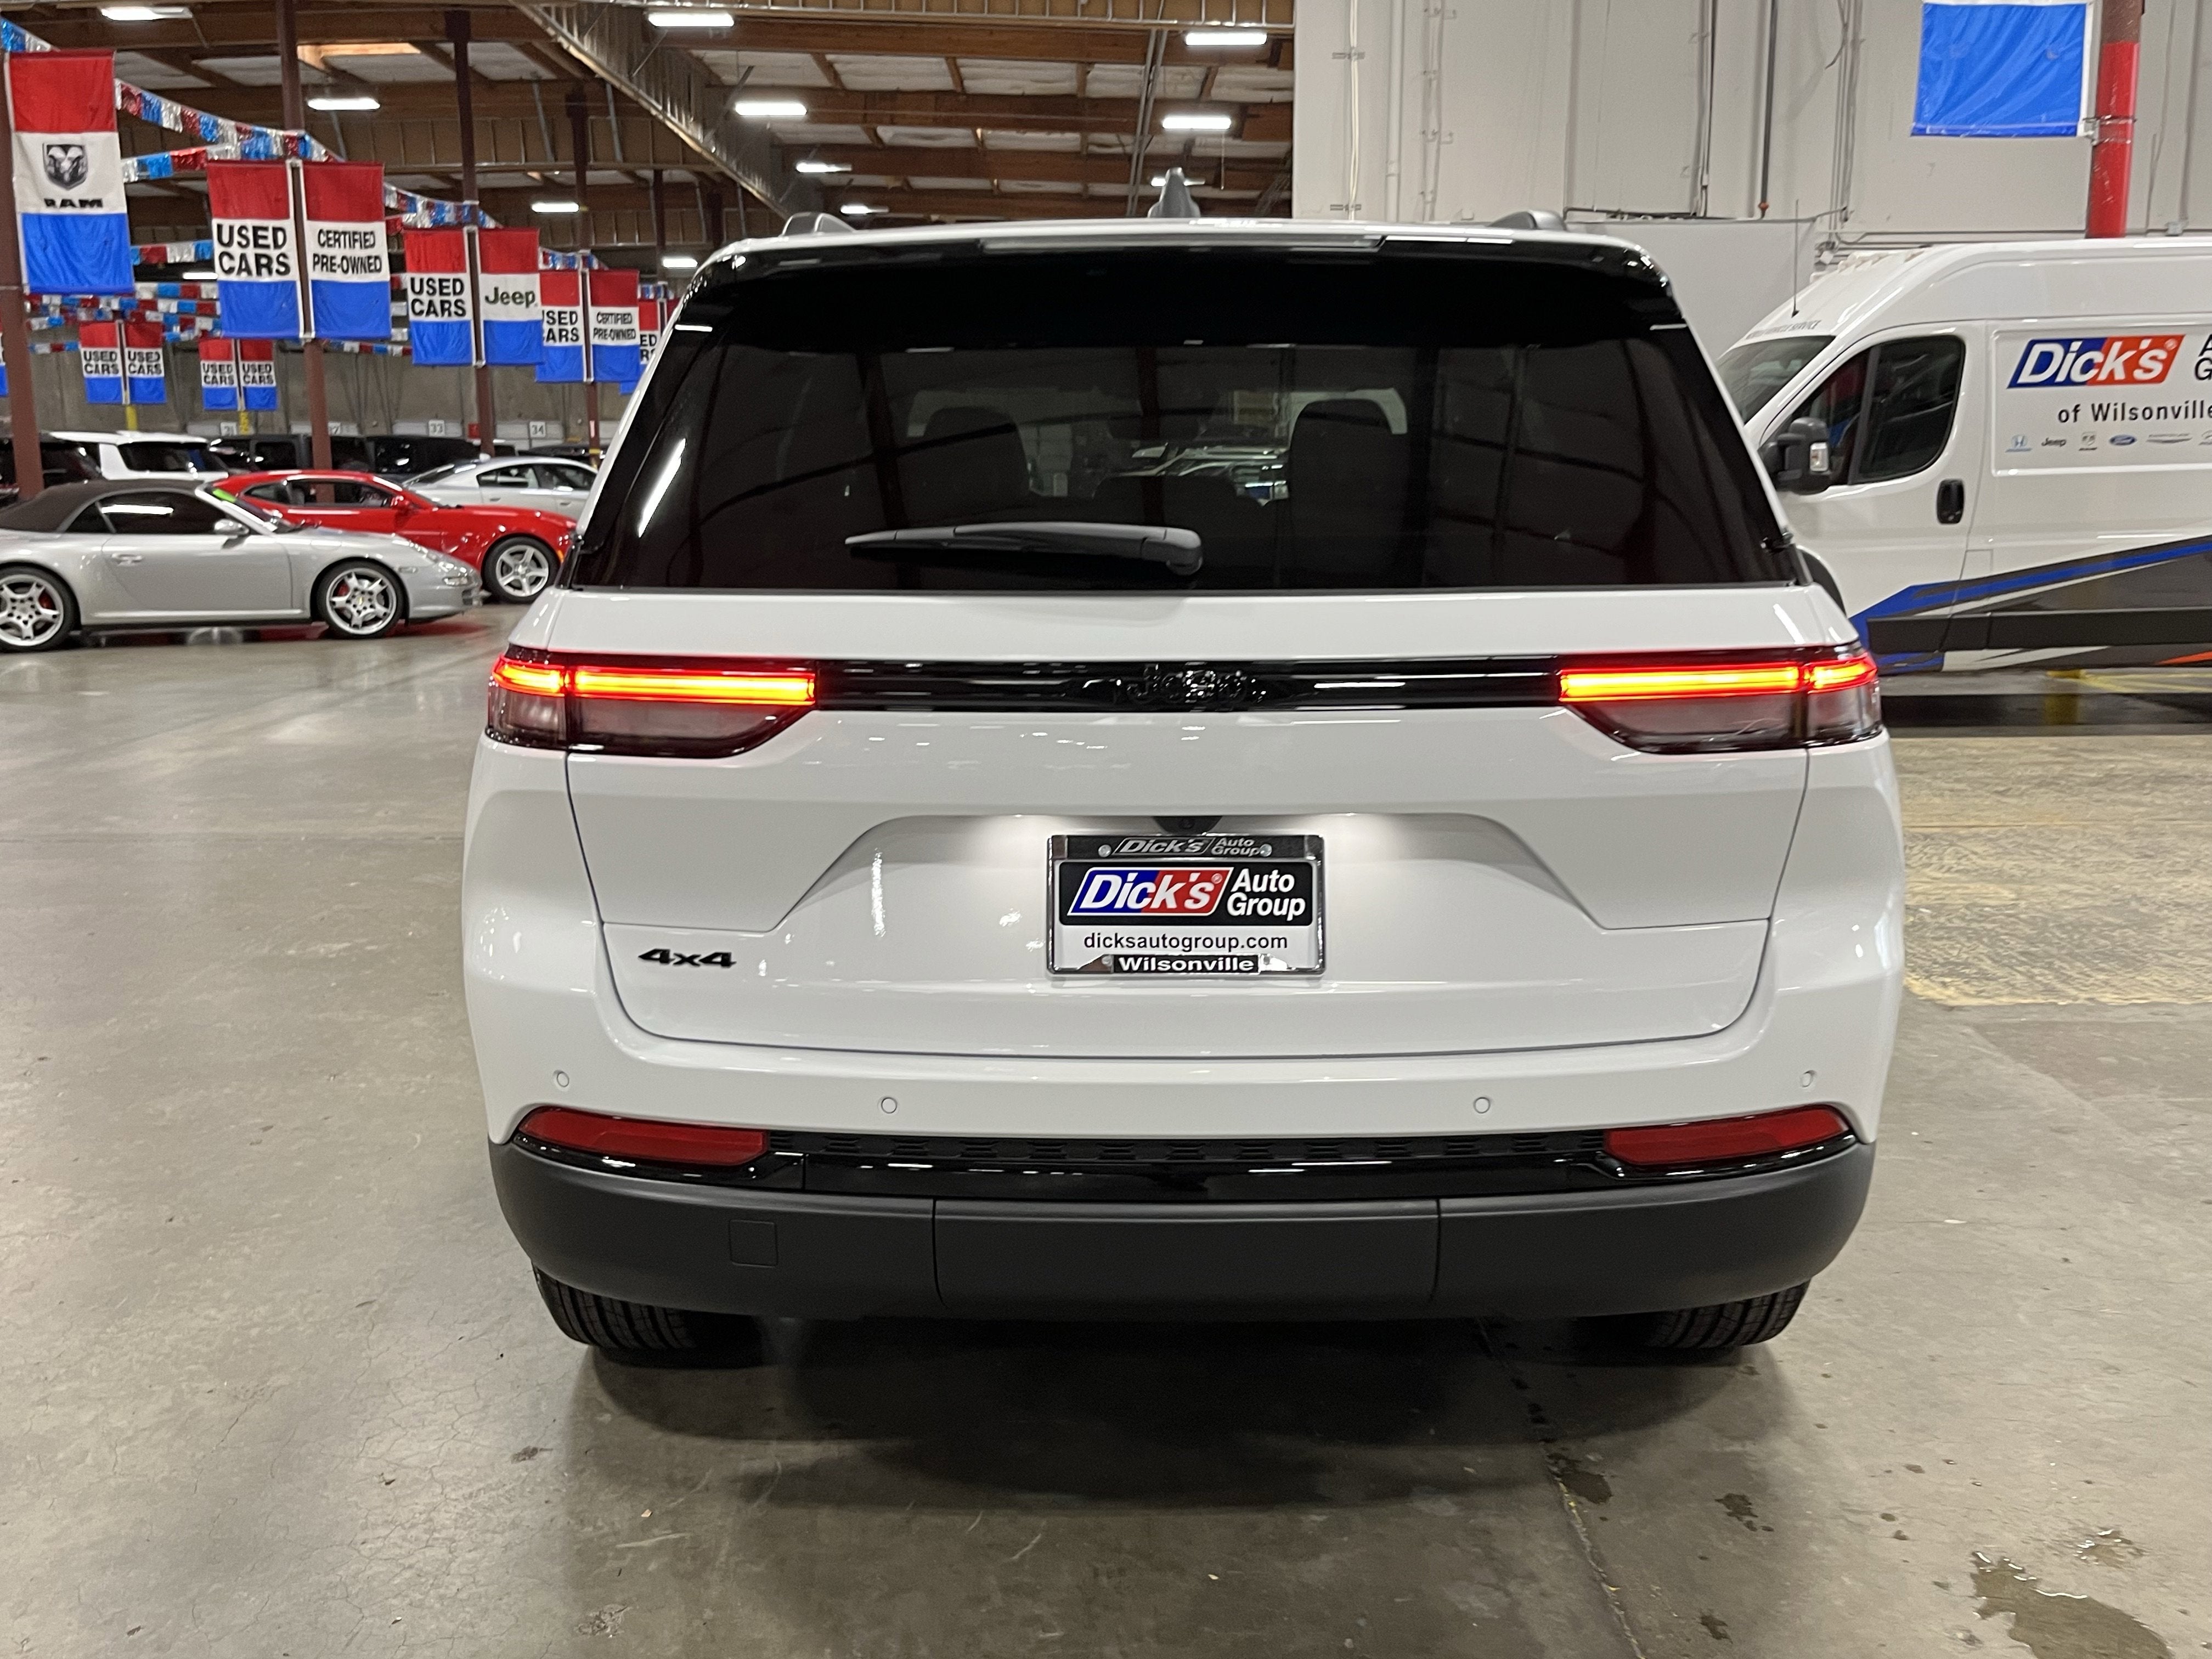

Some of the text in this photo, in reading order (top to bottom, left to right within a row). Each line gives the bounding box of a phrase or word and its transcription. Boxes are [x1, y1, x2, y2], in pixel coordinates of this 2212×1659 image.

[44, 198, 103, 208] RAM
[217, 223, 287, 250] USED
[317, 228, 376, 250] CERTIFIED
[218, 251, 291, 276] CARS
[312, 253, 382, 274] PRE-OWNED
[410, 276, 465, 297] USED
[484, 286, 536, 308] Jeep
[410, 298, 467, 318] CARS
[542, 309, 578, 326] SED
[596, 311, 633, 325] CERTIFIED
[543, 328, 580, 343] ARS
[592, 327, 637, 341] PRE-OWNED
[640, 334, 657, 347] ED
[83, 351, 118, 362] USED
[128, 351, 161, 363] USED
[2016, 338, 2168, 385] Dick's
[84, 363, 119, 375] CARS
[128, 363, 162, 375] CARS
[202, 363, 233, 374] USED
[242, 363, 272, 374] USED
[204, 374, 234, 385] CARS
[243, 374, 274, 385] CARS
[2057, 404, 2081, 424] of
[1119, 837, 1255, 854] Dick's Auto
[1211, 845, 1264, 857] Group
[1079, 868, 1295, 910] Dick's Auto
[1226, 894, 1306, 921] Group
[1083, 933, 1288, 952] dicksautogroup.com
[637, 948, 737, 969] 4x4
[1118, 955, 1255, 972] Wilsonville
